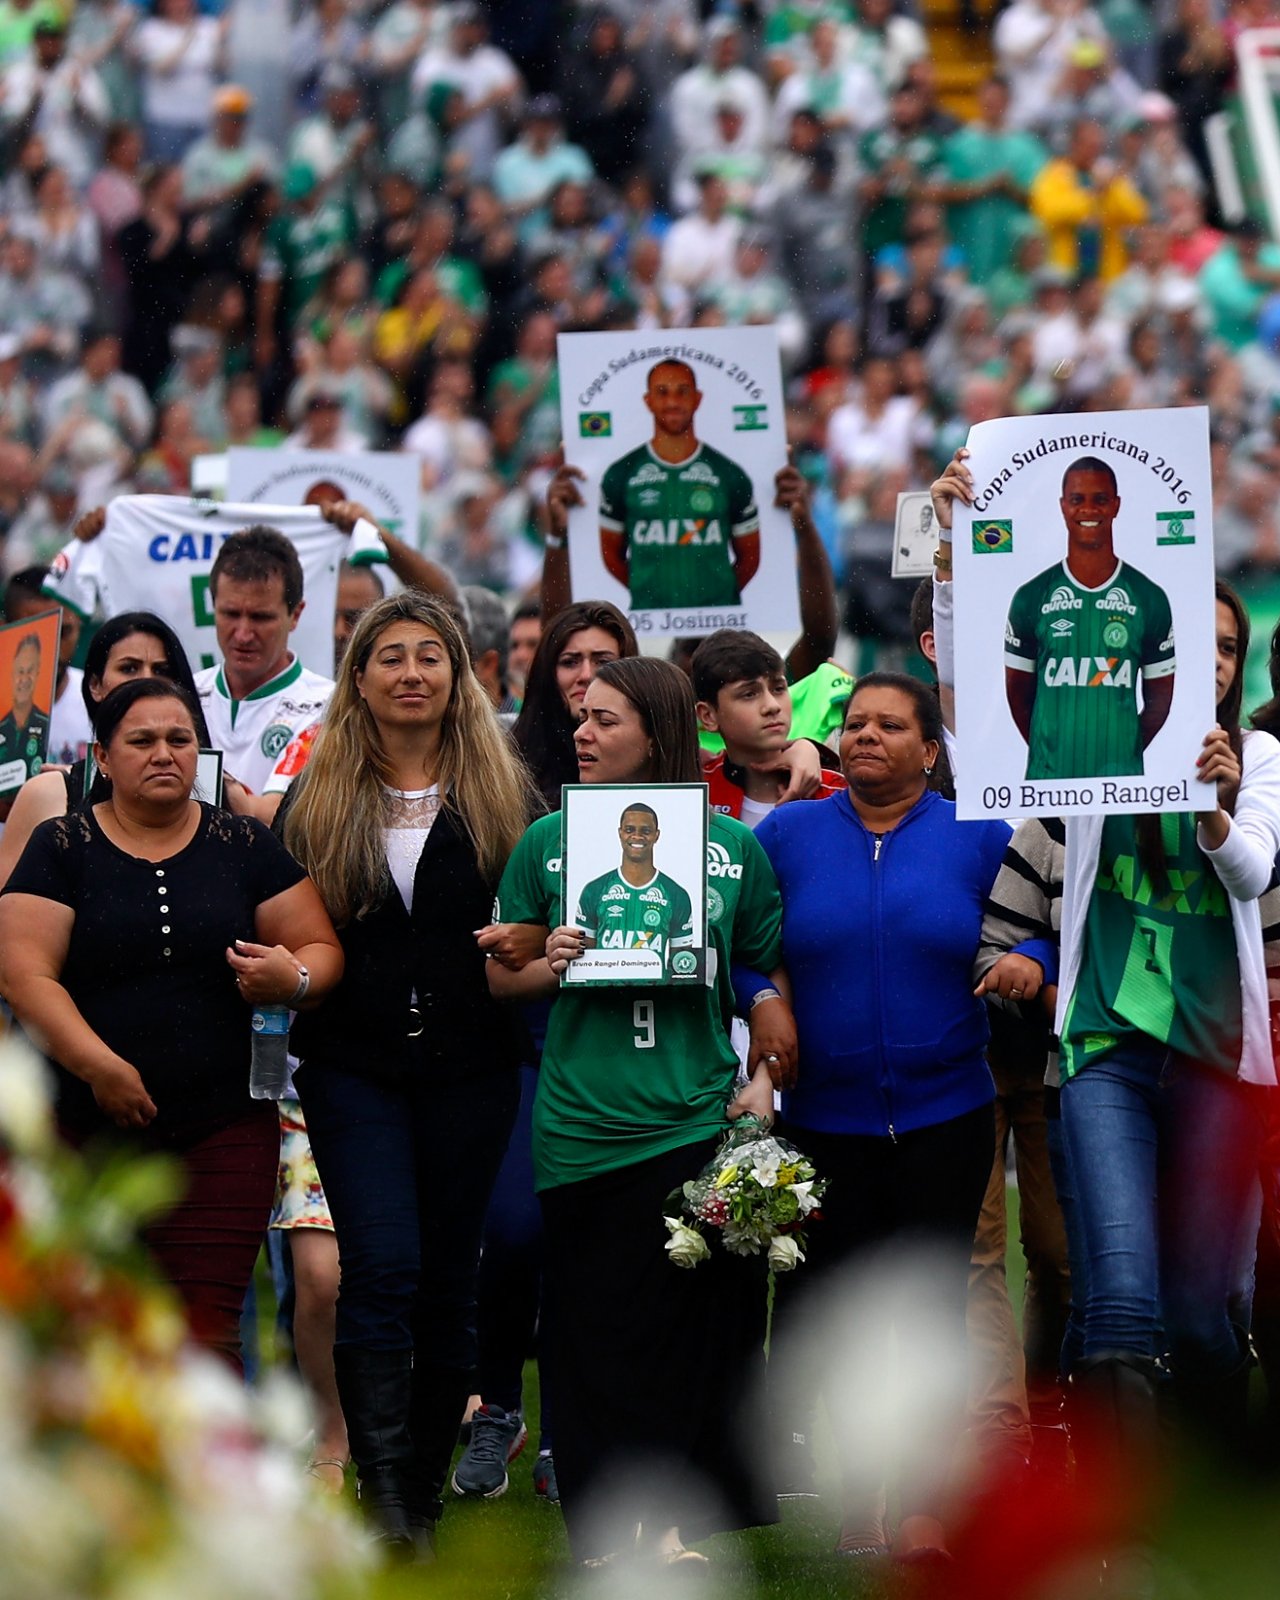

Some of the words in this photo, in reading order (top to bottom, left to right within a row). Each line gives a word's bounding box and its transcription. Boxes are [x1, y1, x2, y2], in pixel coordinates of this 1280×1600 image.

[578, 371, 610, 407] Copa
[608, 343, 725, 374] Sudamericana
[726, 362, 765, 401] 2016
[972, 467, 1013, 513] Copa
[1012, 431, 1150, 471] Sudamericana
[1151, 457, 1192, 505] 2016
[633, 518, 722, 545] CAIXA
[148, 532, 232, 563] CAI
[1041, 598, 1083, 615] aurora
[1095, 598, 1137, 616] aurora
[628, 612, 653, 631] 05
[660, 609, 748, 630] Josimar
[1044, 656, 1132, 689] CAIXA
[983, 786, 1011, 809] 09
[1019, 785, 1094, 808] Bruno
[1101, 779, 1190, 808] Rangel
[601, 892, 631, 902] aurora
[639, 894, 668, 906] aurora
[601, 928, 663, 953] CAIXA
[594, 960, 620, 969] Rangel
[620, 960, 660, 969] Domingues
[633, 999, 656, 1049] 9
